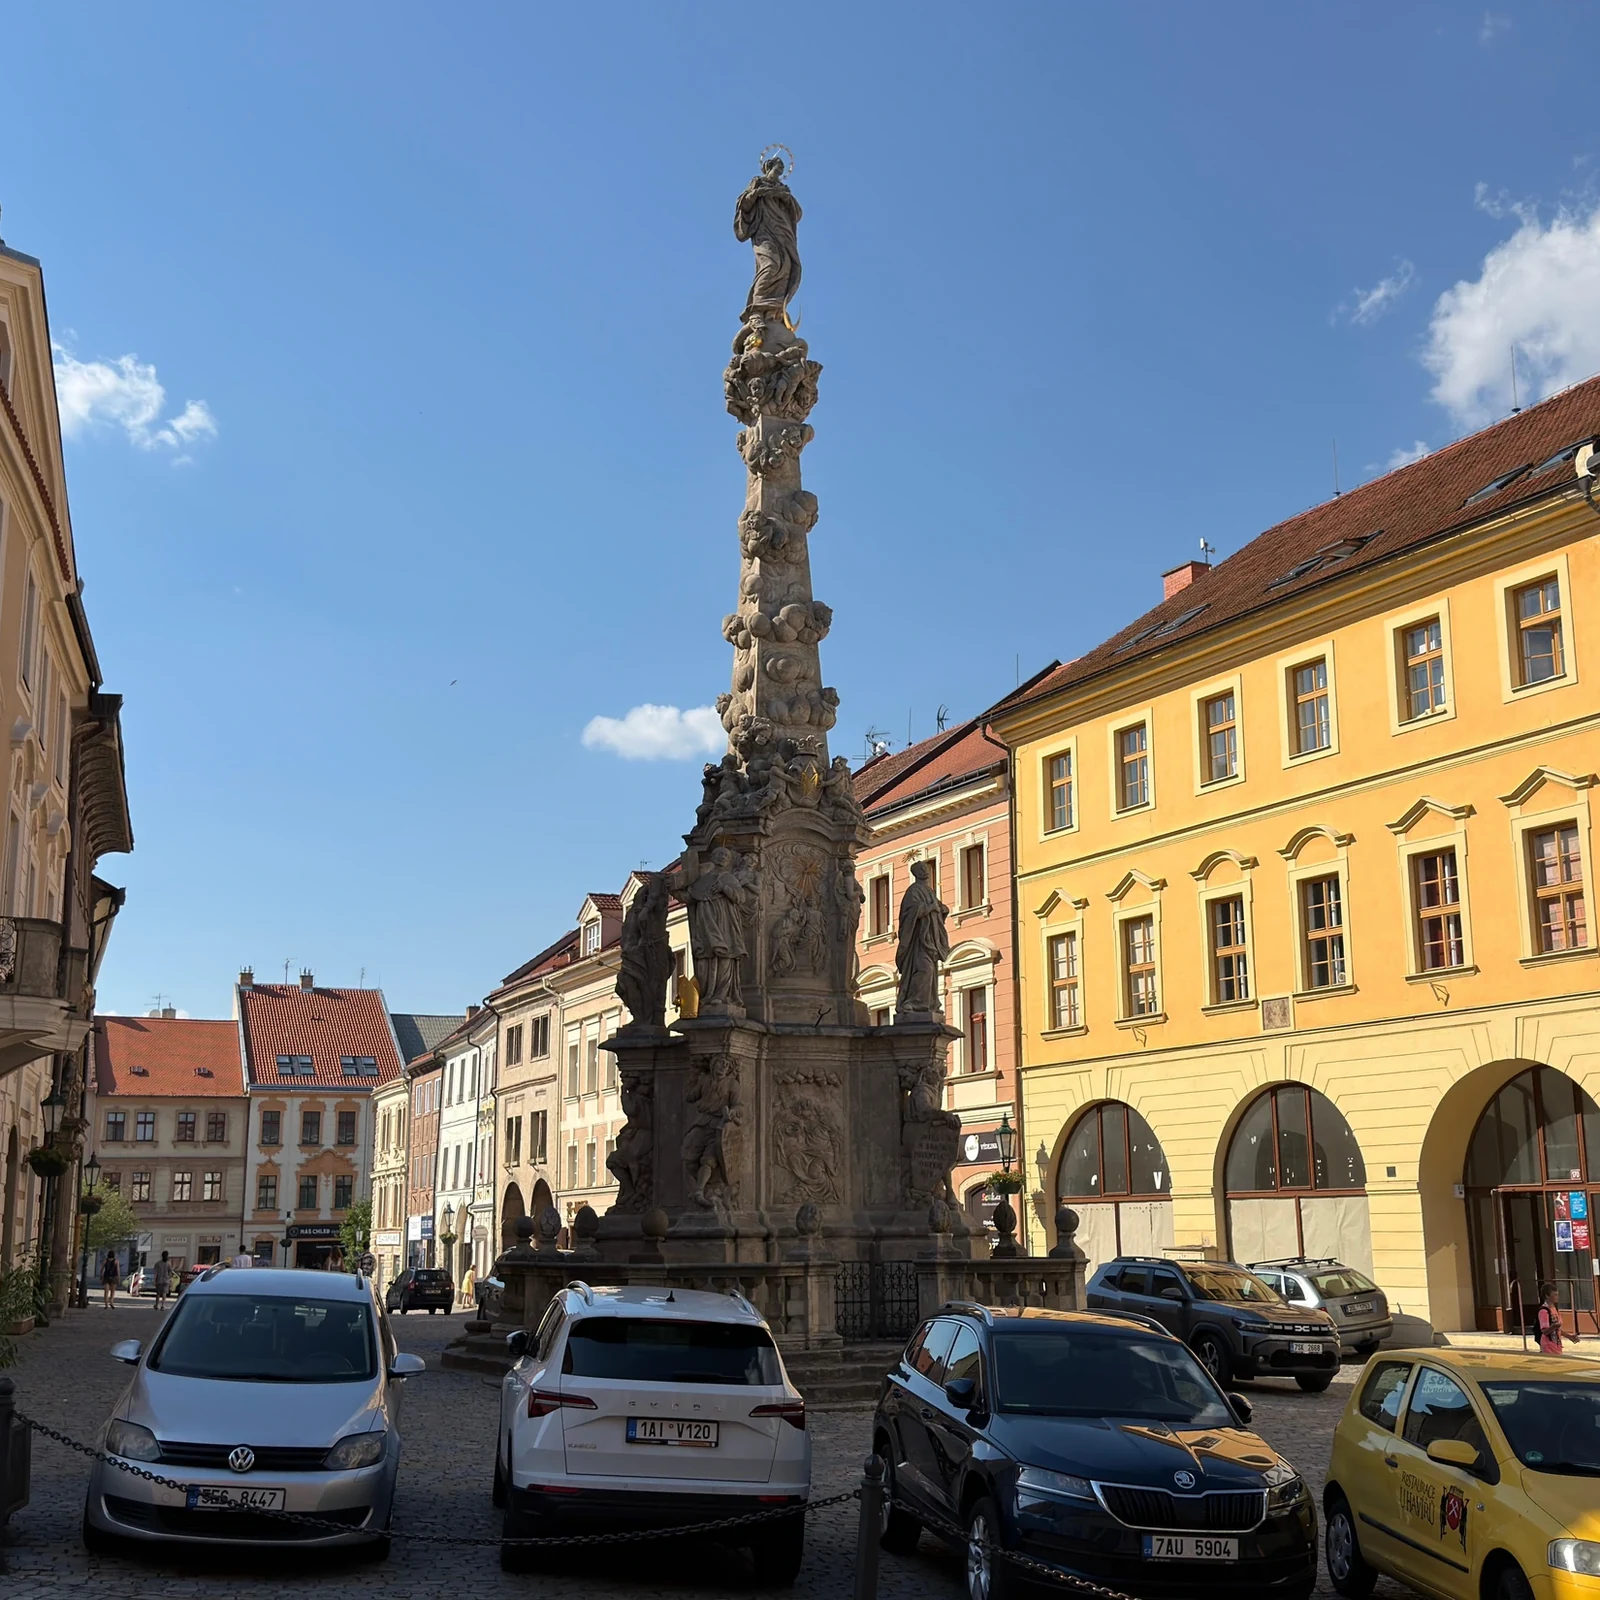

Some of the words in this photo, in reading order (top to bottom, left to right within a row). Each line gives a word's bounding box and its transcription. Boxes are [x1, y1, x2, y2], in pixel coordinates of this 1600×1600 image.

[641, 1421, 663, 1438] 1AI
[677, 1423, 711, 1440] V120
[240, 1491, 277, 1509] 8447
[1155, 1538, 1184, 1555] 7AU
[1195, 1540, 1231, 1557] 5904
